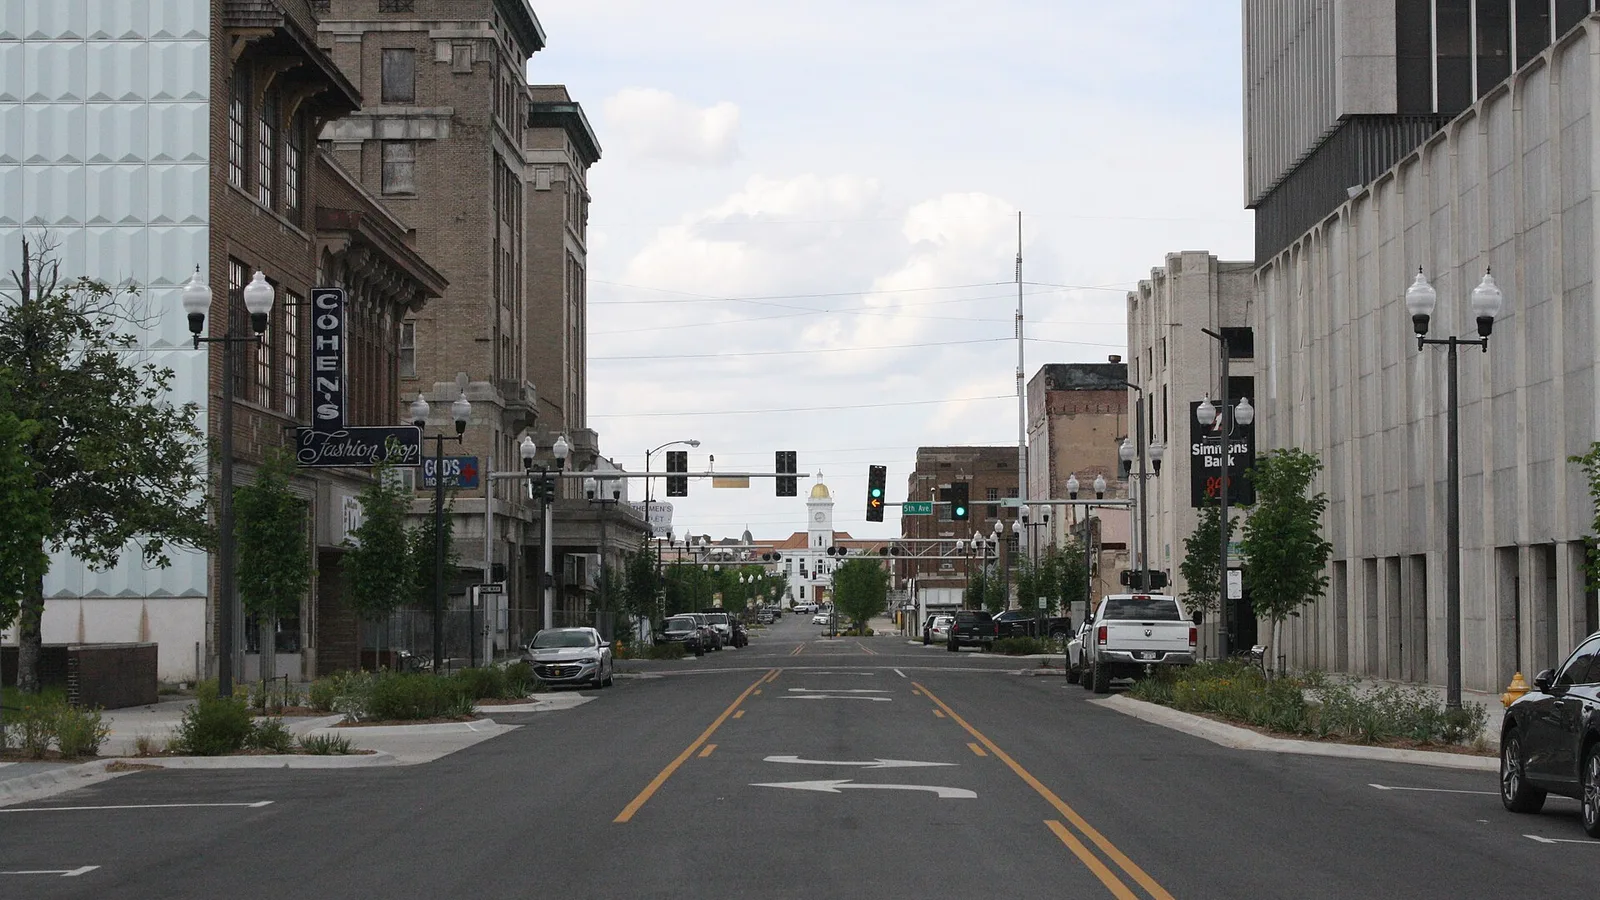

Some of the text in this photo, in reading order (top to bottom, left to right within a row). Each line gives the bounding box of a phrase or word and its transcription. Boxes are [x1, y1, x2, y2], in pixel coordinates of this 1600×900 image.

[297, 430, 418, 464] Fashion Shop
[1192, 443, 1248, 455] Simmons
